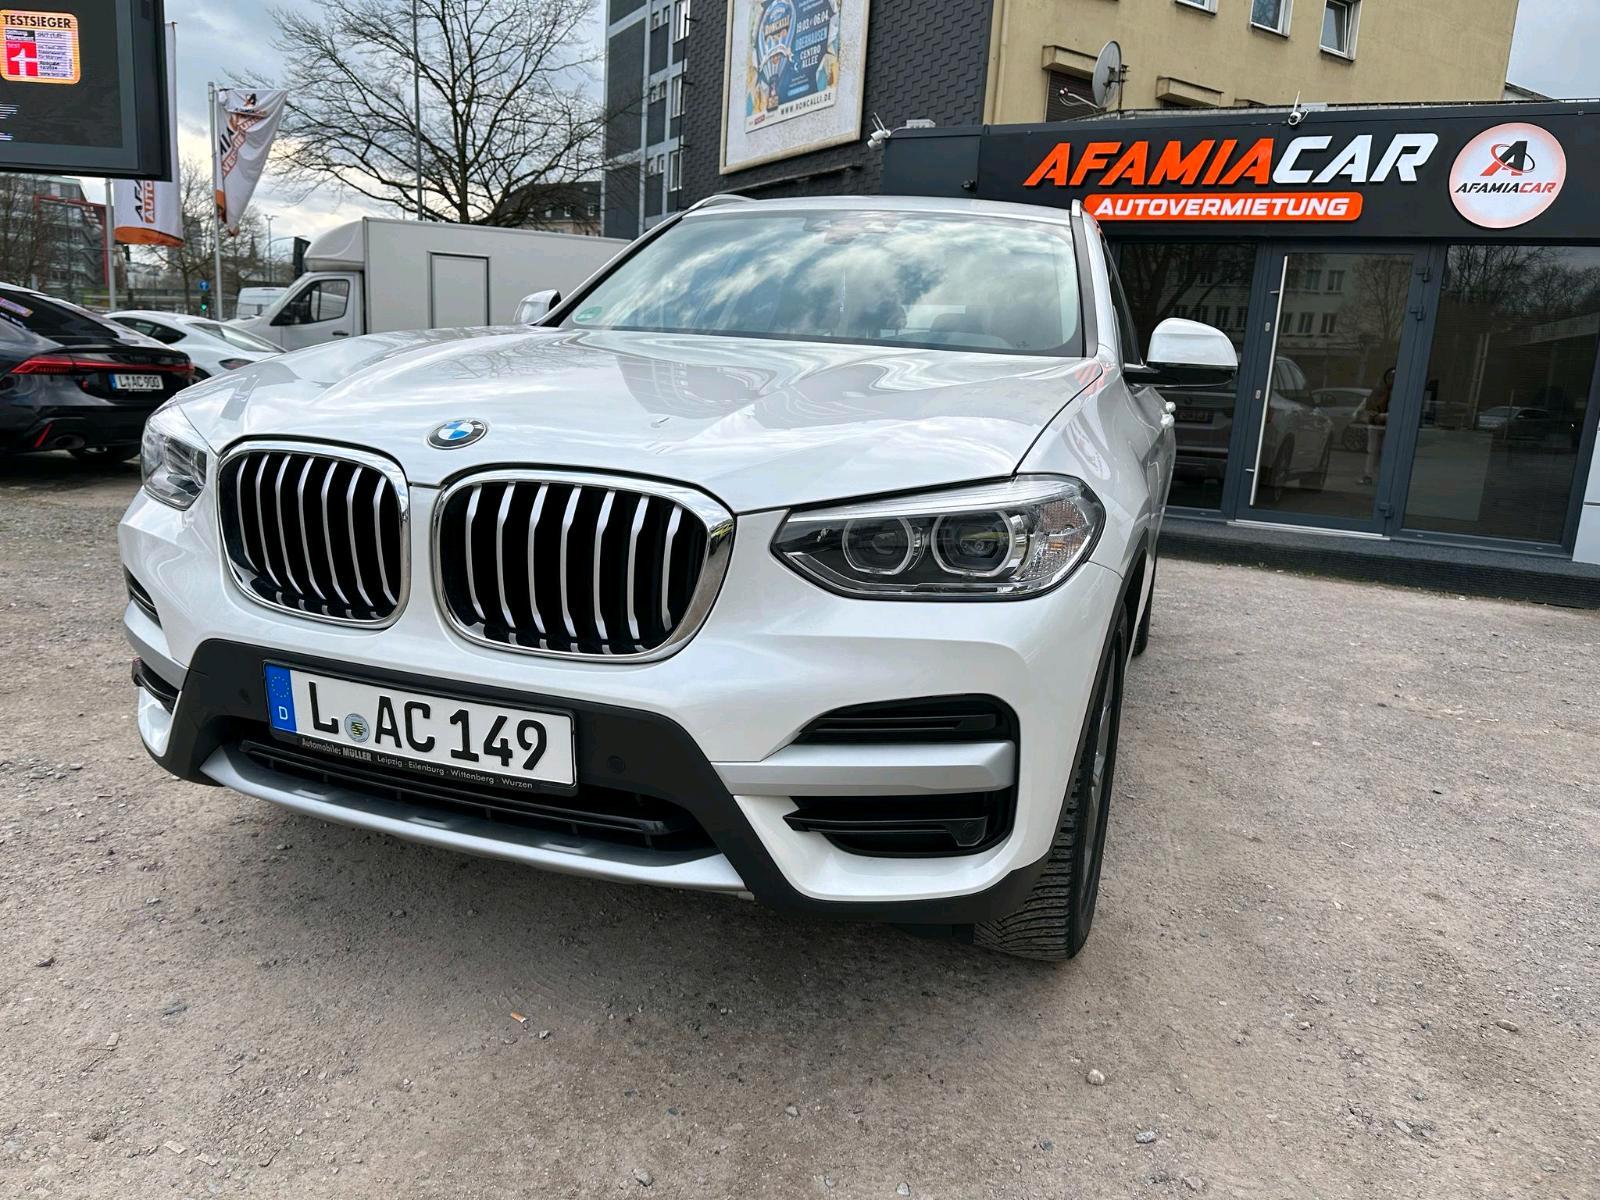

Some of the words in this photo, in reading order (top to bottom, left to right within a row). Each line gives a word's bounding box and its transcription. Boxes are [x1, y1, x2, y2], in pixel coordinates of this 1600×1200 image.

[3, 15, 71, 28] TESTSIEGER
[1023, 133, 1439, 187] AFAMIACAR
[1455, 182, 1557, 194] AFAMIACAR
[1094, 196, 1349, 219] AUTOVERMIETUNG
[278, 705, 288, 721] D
[308, 681, 339, 734] L
[374, 695, 436, 754] AC
[449, 709, 548, 771] 149
[342, 747, 372, 762] MÜLLER
[377, 754, 402, 768] Leipzig
[408, 760, 445, 776] Eilenburg
[450, 769, 495, 784] Wittenberg
[501, 777, 533, 789] Wurzen
